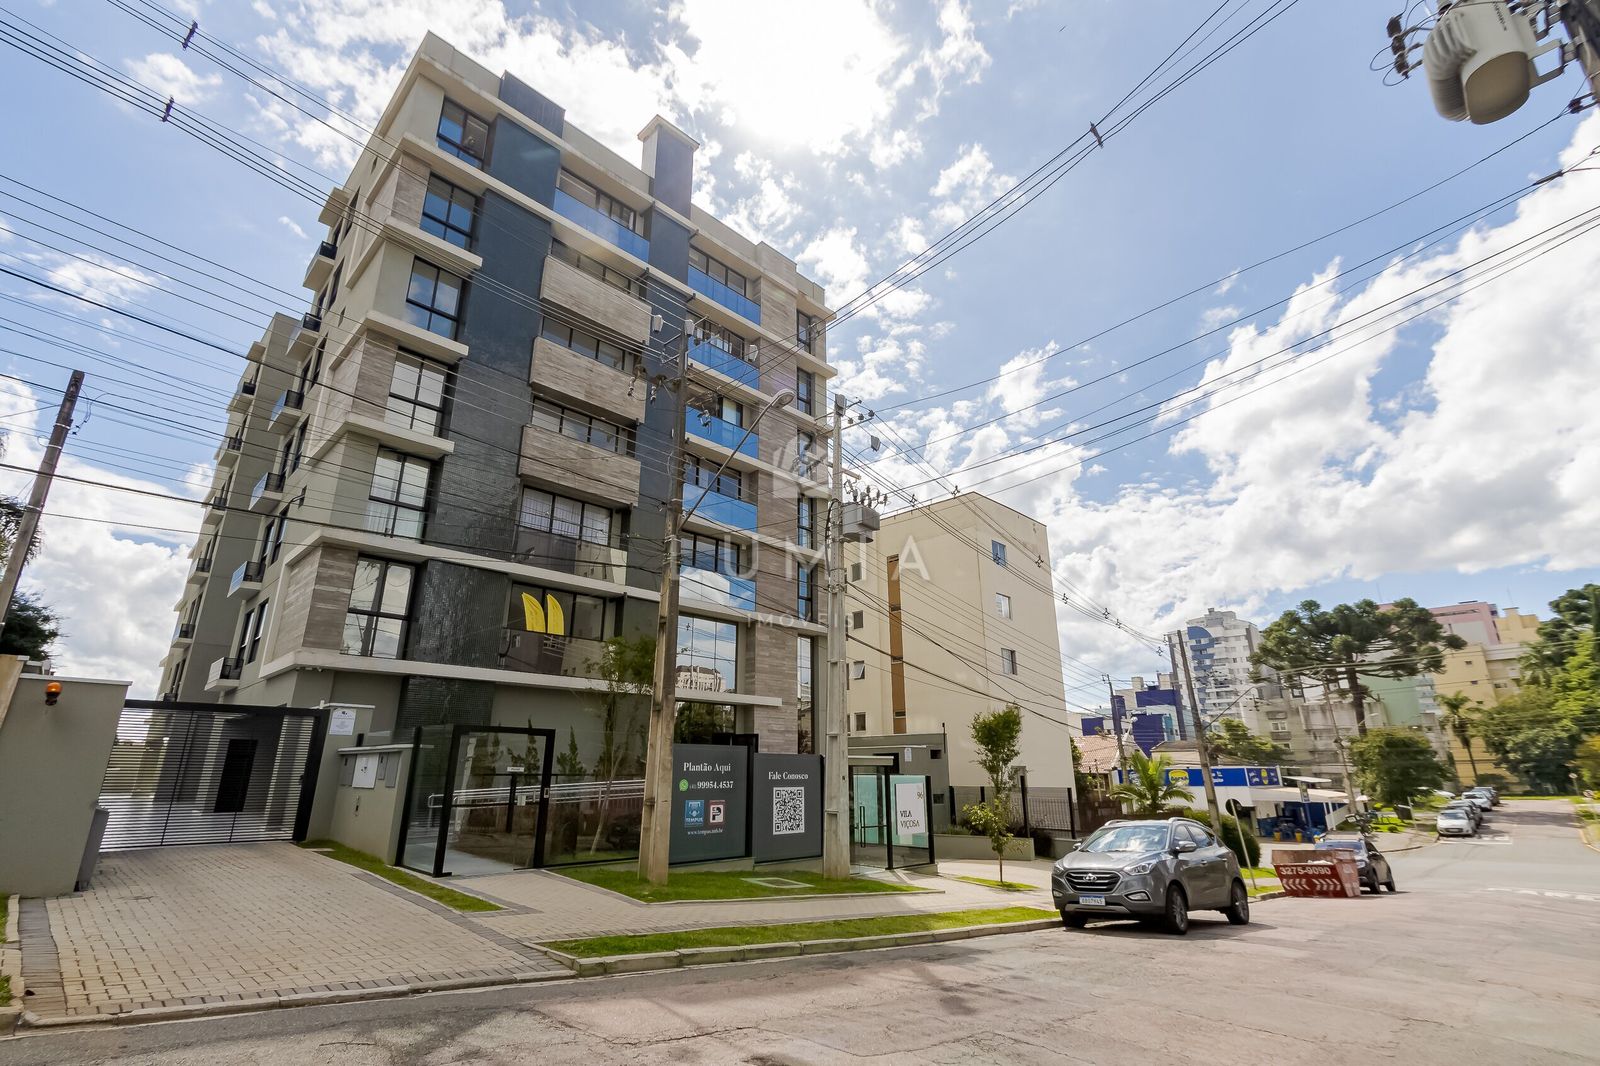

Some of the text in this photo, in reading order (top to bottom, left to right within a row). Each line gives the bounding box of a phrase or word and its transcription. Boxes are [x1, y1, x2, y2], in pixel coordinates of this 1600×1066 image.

[683, 762, 731, 774] Plantão Aqui
[768, 771, 809, 780] Fale Conosco
[697, 780, 734, 789] 99954.4537
[900, 810, 912, 818] VILA
[900, 820, 920, 829] VIÇOSA
[1279, 866, 1331, 875] 3275-9090
